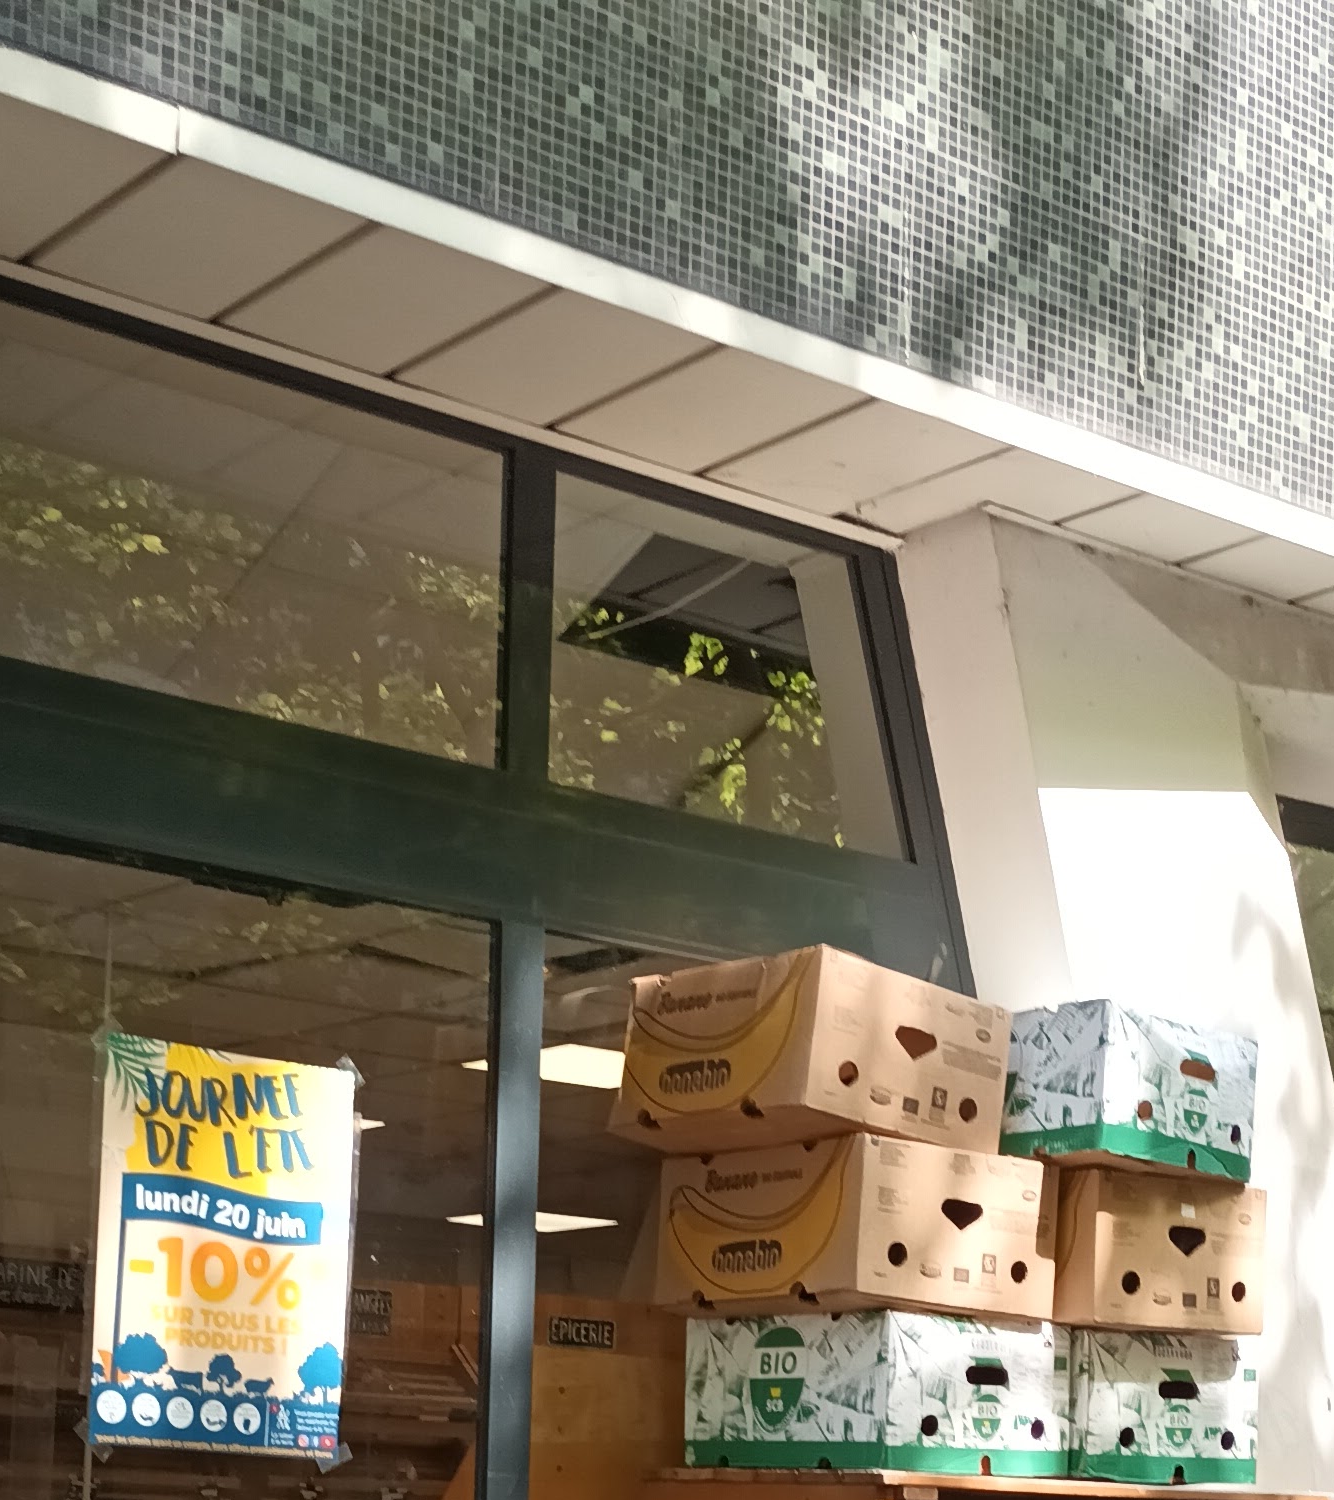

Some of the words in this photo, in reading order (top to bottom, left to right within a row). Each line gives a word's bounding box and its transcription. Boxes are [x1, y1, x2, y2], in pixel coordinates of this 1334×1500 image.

[146, 1117, 199, 1172] DE
[134, 1183, 211, 1220] lundi
[213, 1198, 251, 1230] 20
[252, 1208, 307, 1240] juin
[151, 1304, 194, 1326] SUR
[201, 1309, 260, 1332] TOUS
[164, 1325, 276, 1355] PRODUITS
[759, 1351, 798, 1375] BIO
